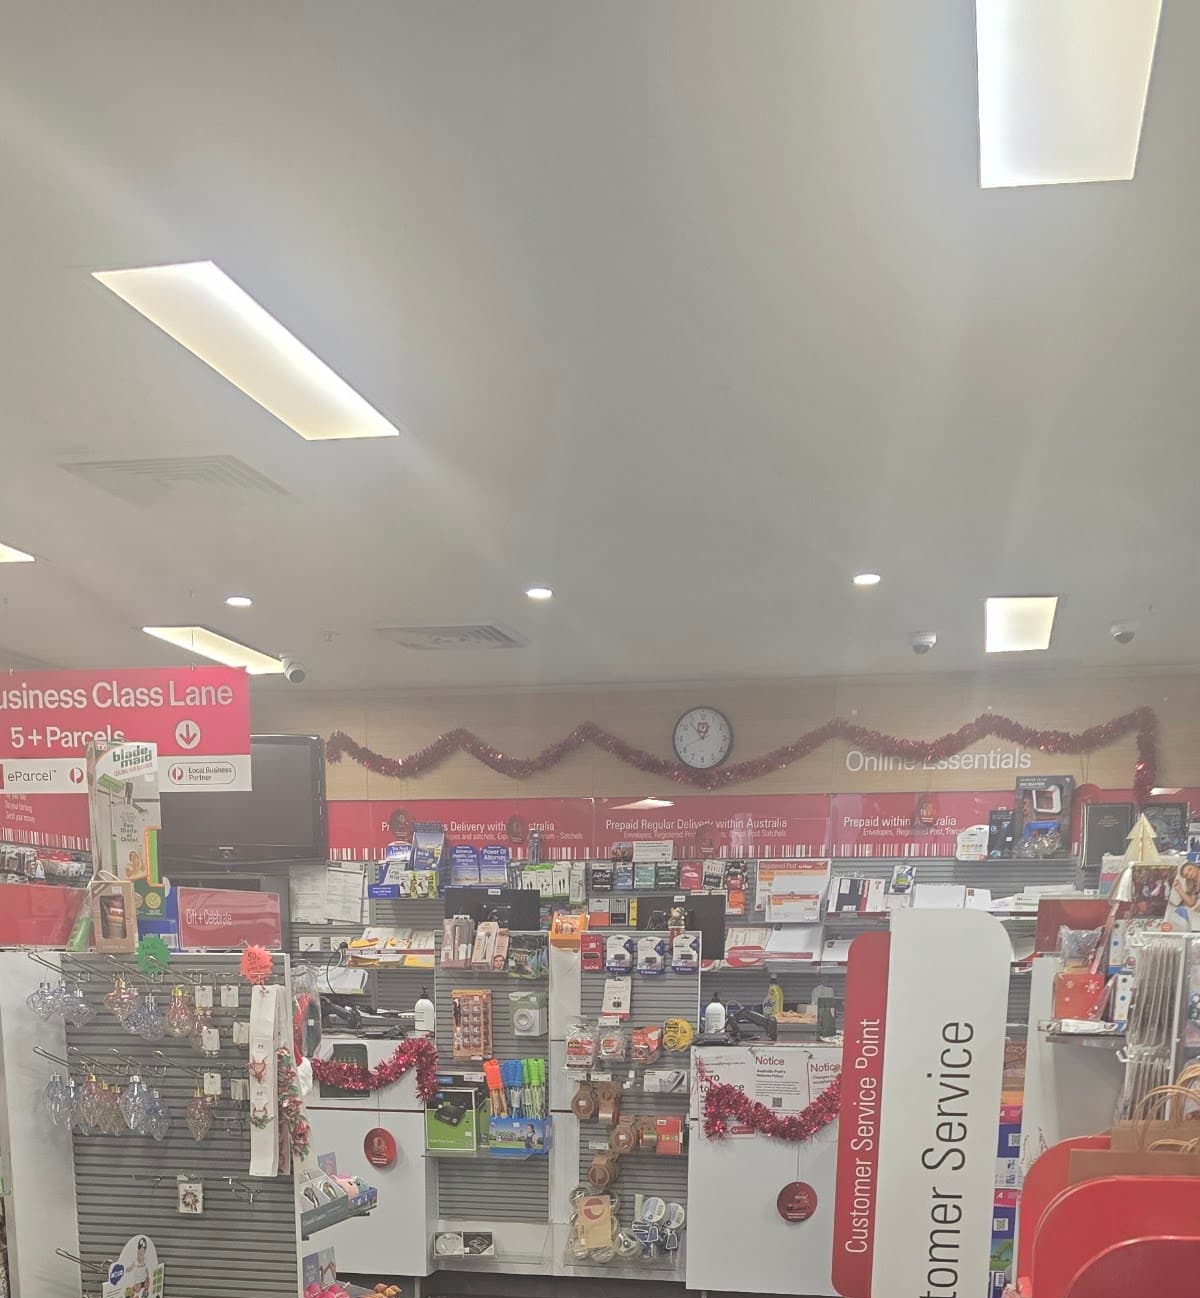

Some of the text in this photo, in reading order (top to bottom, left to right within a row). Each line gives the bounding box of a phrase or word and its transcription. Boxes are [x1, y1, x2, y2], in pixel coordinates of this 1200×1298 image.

[0, 680, 233, 710] usiness Class Lane
[10, 726, 25, 748] 5
[46, 724, 126, 748] Parcels
[112, 744, 149, 762] blade
[120, 749, 153, 768] maid
[845, 750, 916, 772] Online
[206, 766, 232, 774] Business
[450, 820, 485, 833] Delivery
[487, 820, 507, 832] with
[528, 820, 555, 831] stralia
[606, 819, 639, 832] Prepaid
[641, 818, 675, 831] Regular
[716, 818, 744, 829] within
[746, 817, 787, 829] Australia
[843, 815, 957, 829] Prepaid within Aralia
[755, 1056, 785, 1066] Notice
[810, 1062, 840, 1073] Notice
[921, 1021, 974, 1171] Service
[844, 1018, 880, 1254] Customer Service Point
